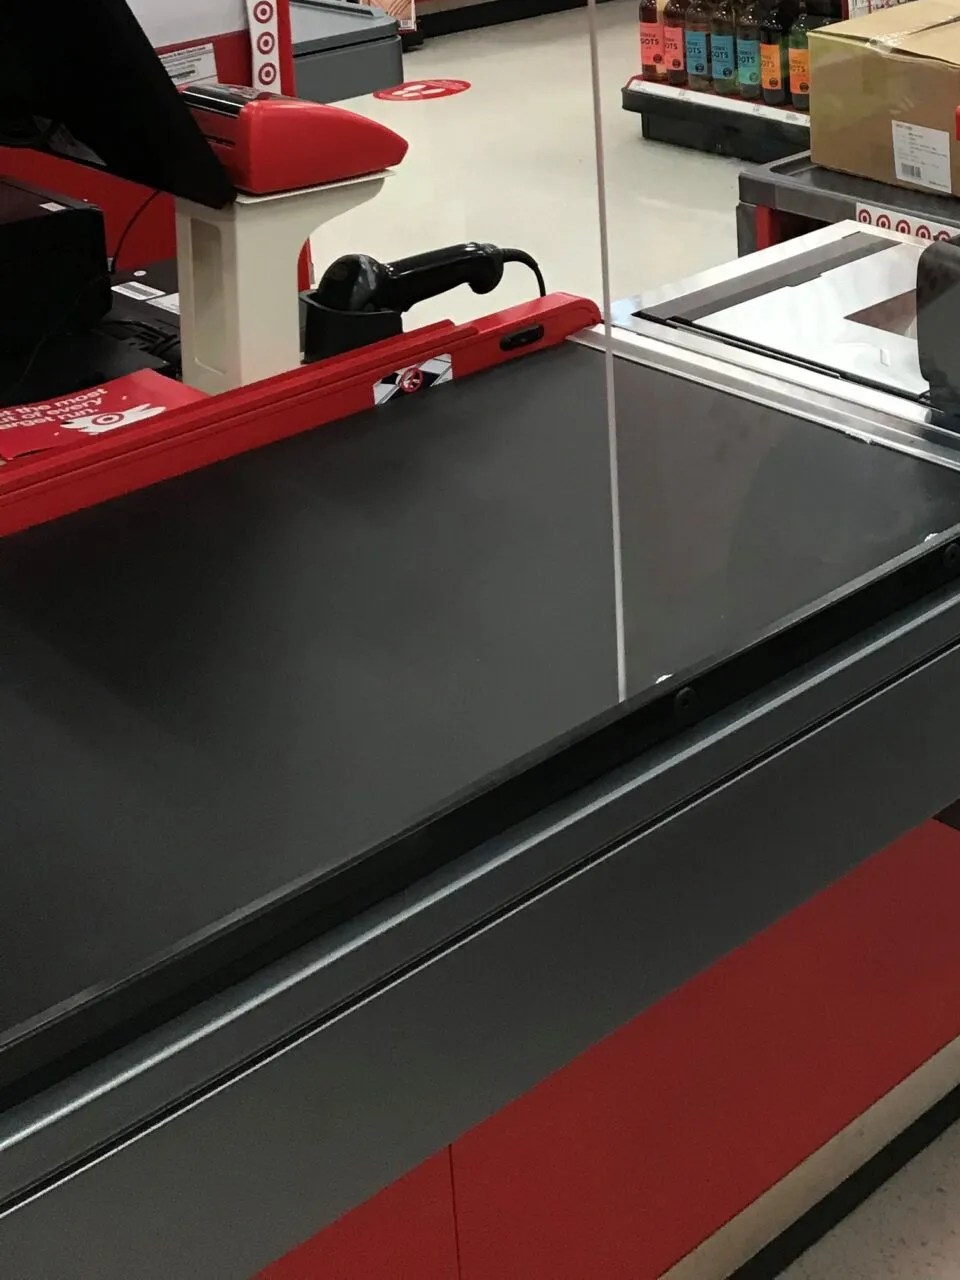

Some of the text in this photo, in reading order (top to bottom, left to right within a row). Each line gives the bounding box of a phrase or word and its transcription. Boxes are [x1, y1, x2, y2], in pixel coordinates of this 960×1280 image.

[15, 404, 52, 415] the
[54, 388, 108, 408] most
[21, 411, 42, 420] of
[46, 397, 102, 416] every
[0, 407, 99, 430] arget run.
